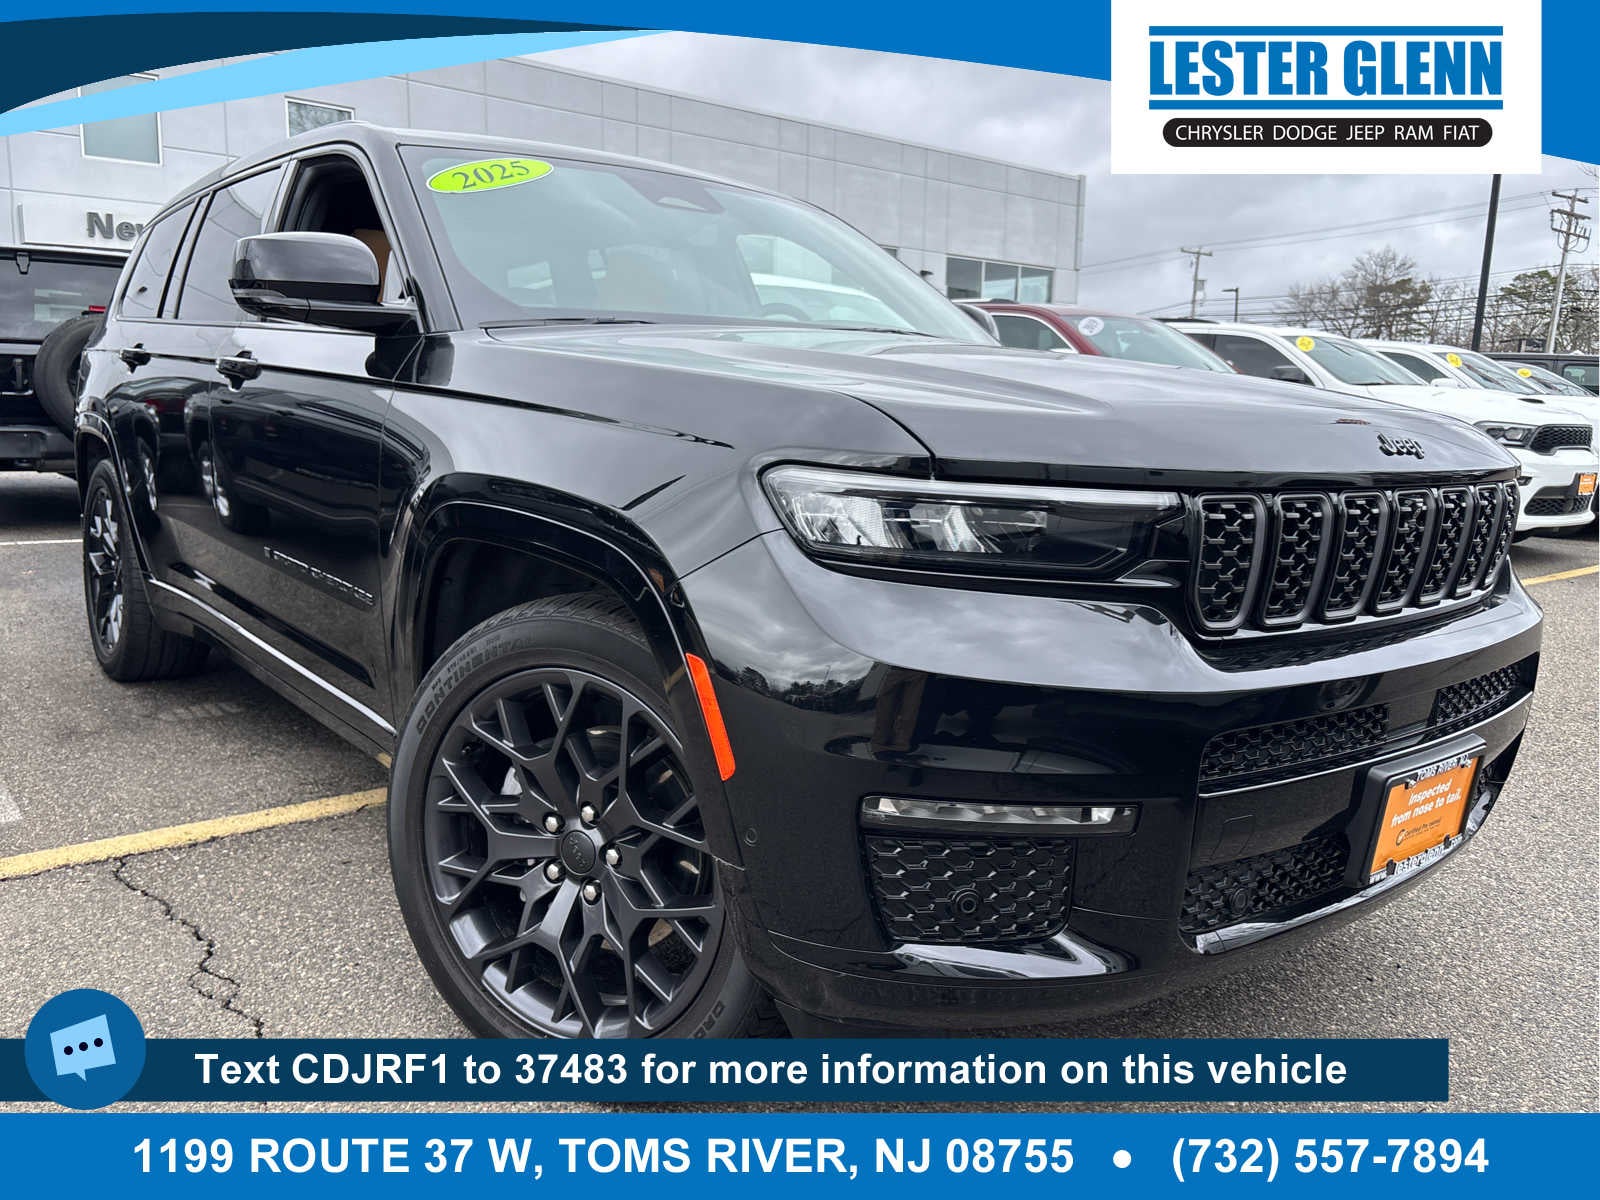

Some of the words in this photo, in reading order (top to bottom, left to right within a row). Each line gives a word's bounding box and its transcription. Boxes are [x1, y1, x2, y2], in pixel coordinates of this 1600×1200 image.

[452, 160, 530, 190] 2025
[1377, 430, 1425, 460] Jeep
[1408, 779, 1452, 807] Inspected
[1391, 811, 1411, 828] from
[1412, 801, 1435, 819] nose
[1435, 795, 1446, 809] to
